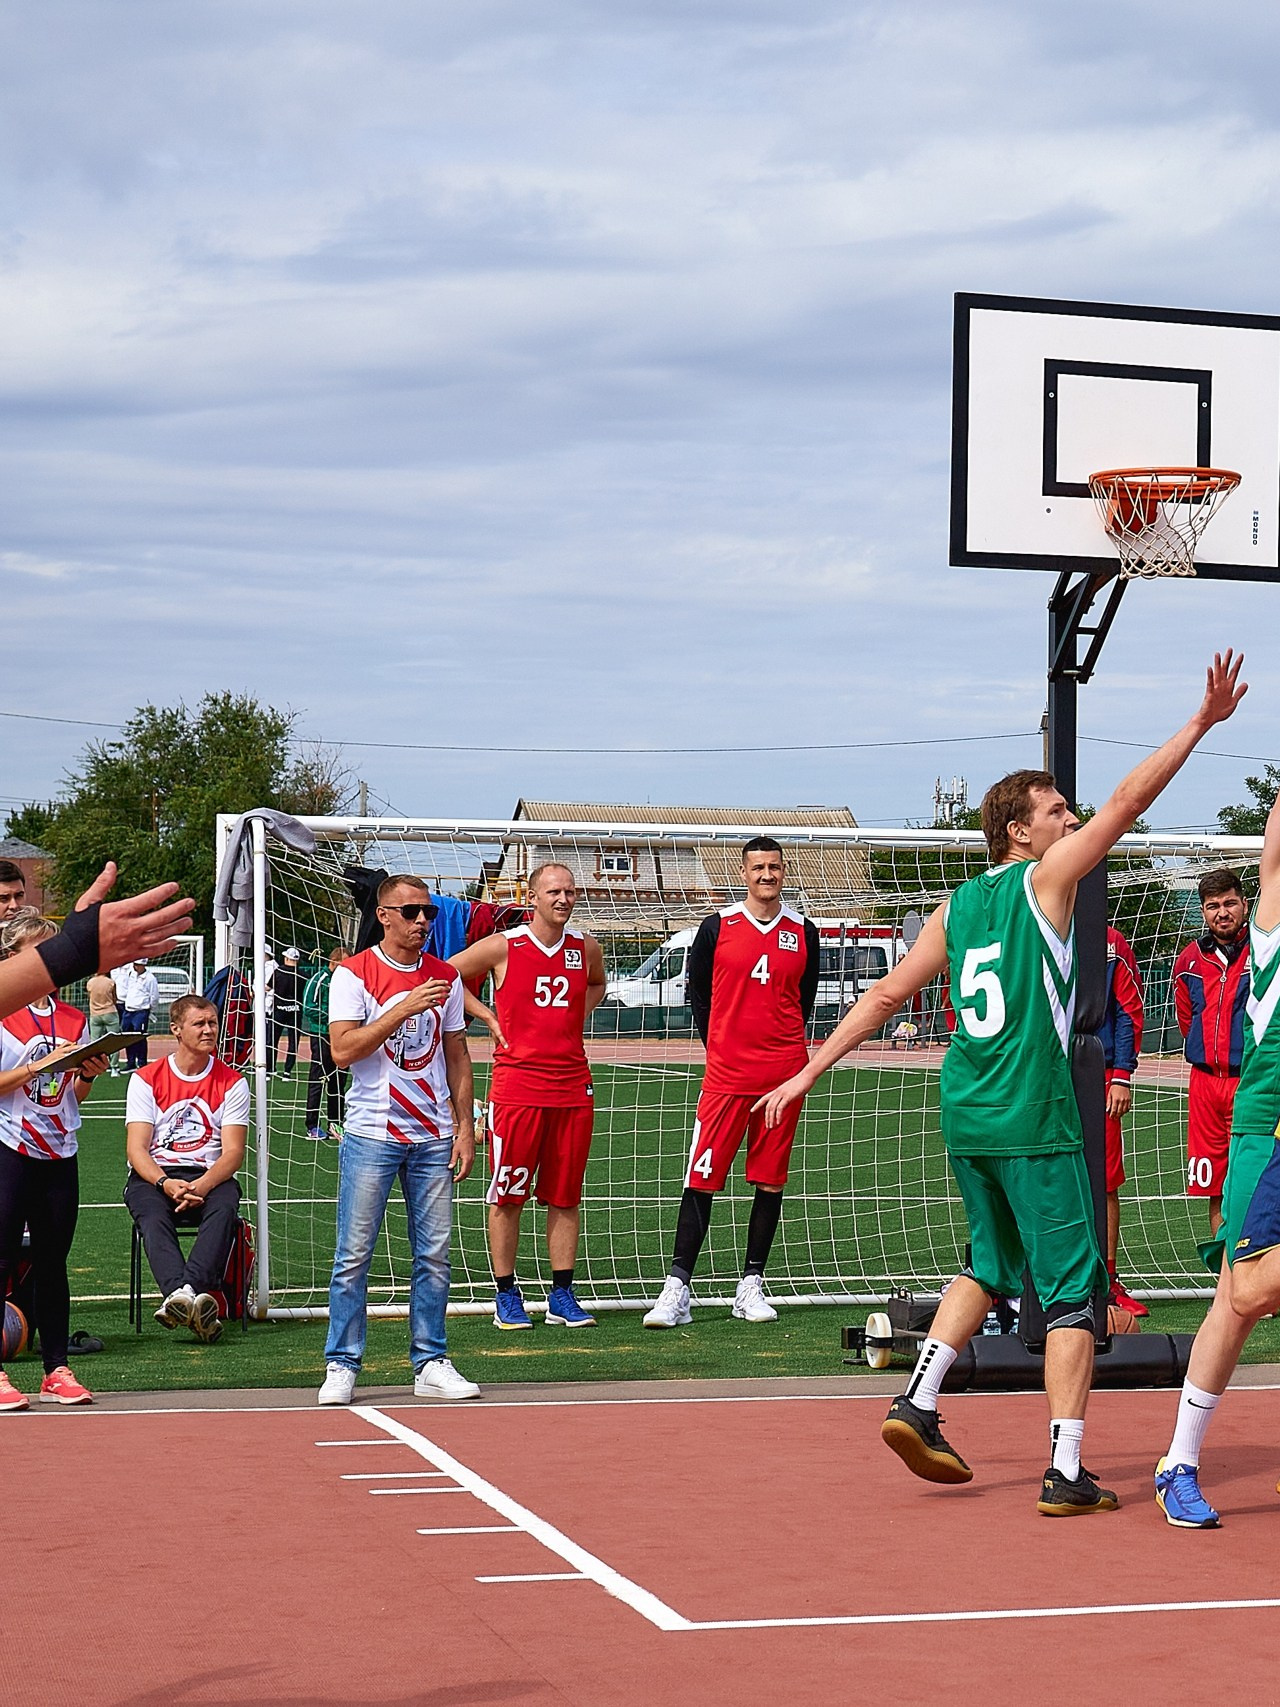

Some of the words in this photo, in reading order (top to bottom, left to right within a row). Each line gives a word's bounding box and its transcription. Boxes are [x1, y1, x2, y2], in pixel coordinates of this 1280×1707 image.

[750, 953, 771, 985] 4
[534, 976, 570, 1008] 52
[960, 941, 1006, 1038] 5
[693, 1147, 713, 1179] 4
[1187, 1156, 1213, 1188] 40
[496, 1165, 529, 1196] 52
